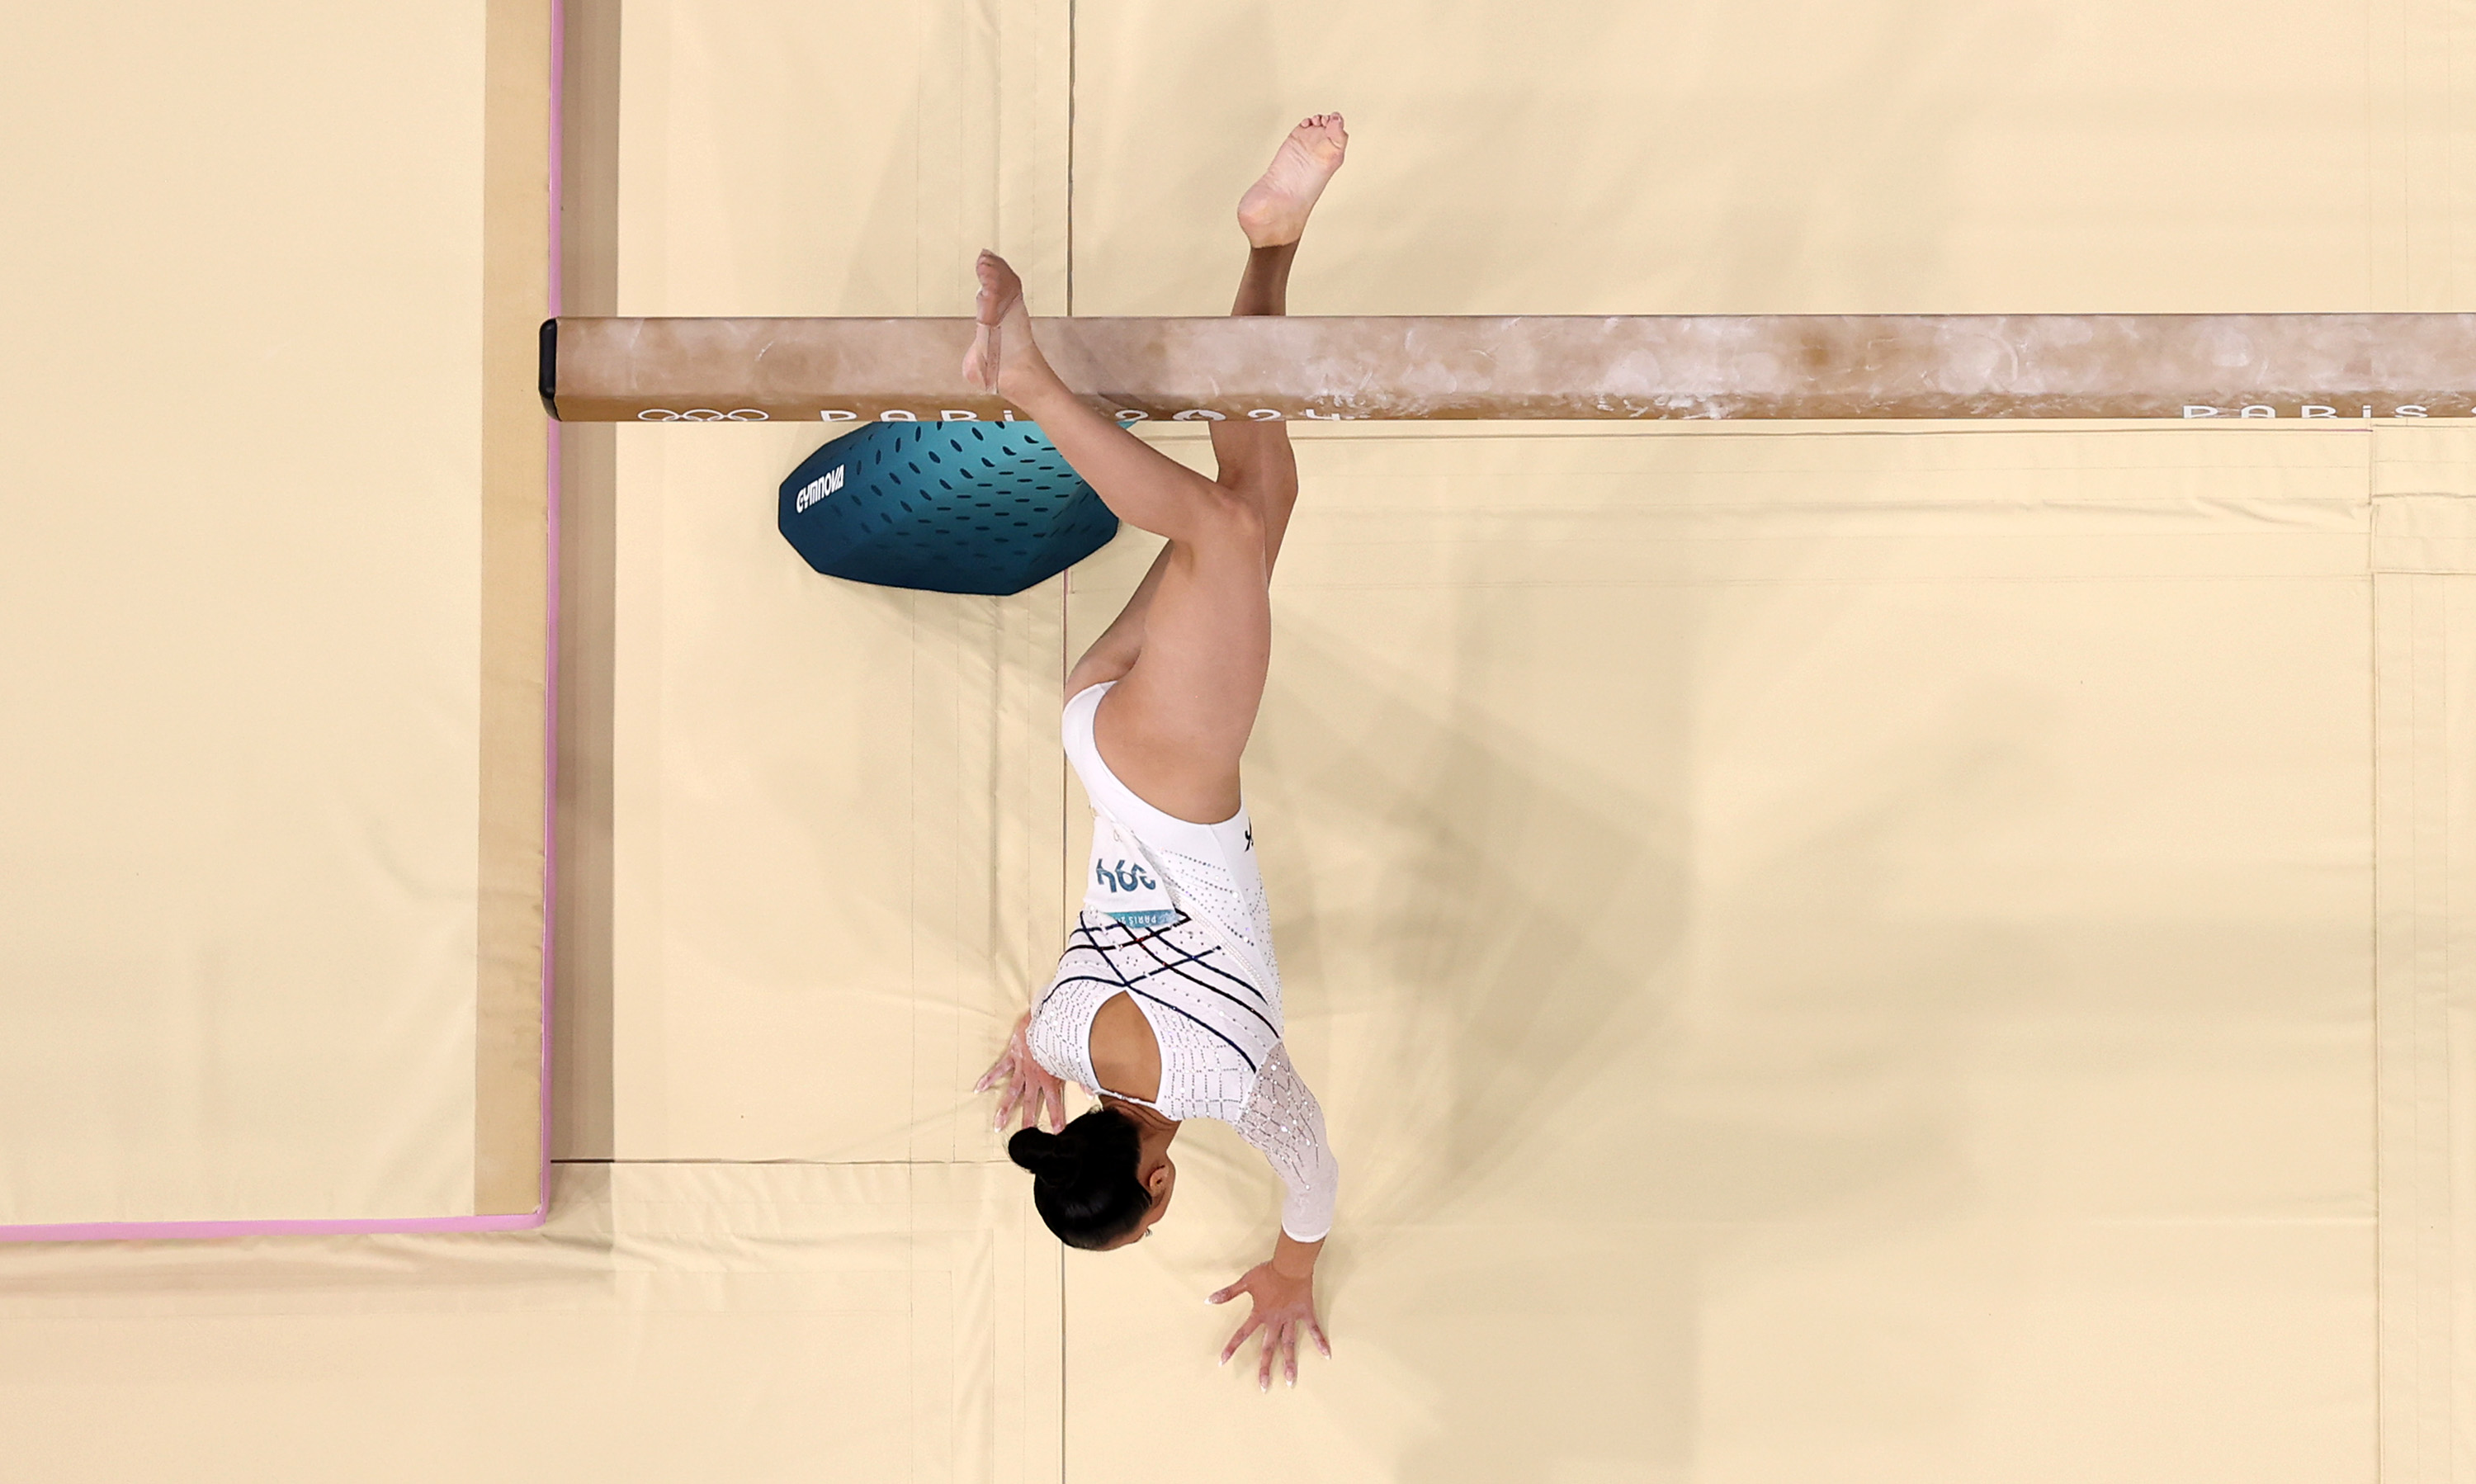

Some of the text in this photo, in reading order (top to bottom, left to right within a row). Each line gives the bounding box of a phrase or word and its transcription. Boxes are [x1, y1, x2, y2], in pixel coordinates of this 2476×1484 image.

[820, 409, 1015, 422] PARi
[796, 464, 845, 513] GYMNOVA
[1096, 858, 1156, 893] 394
